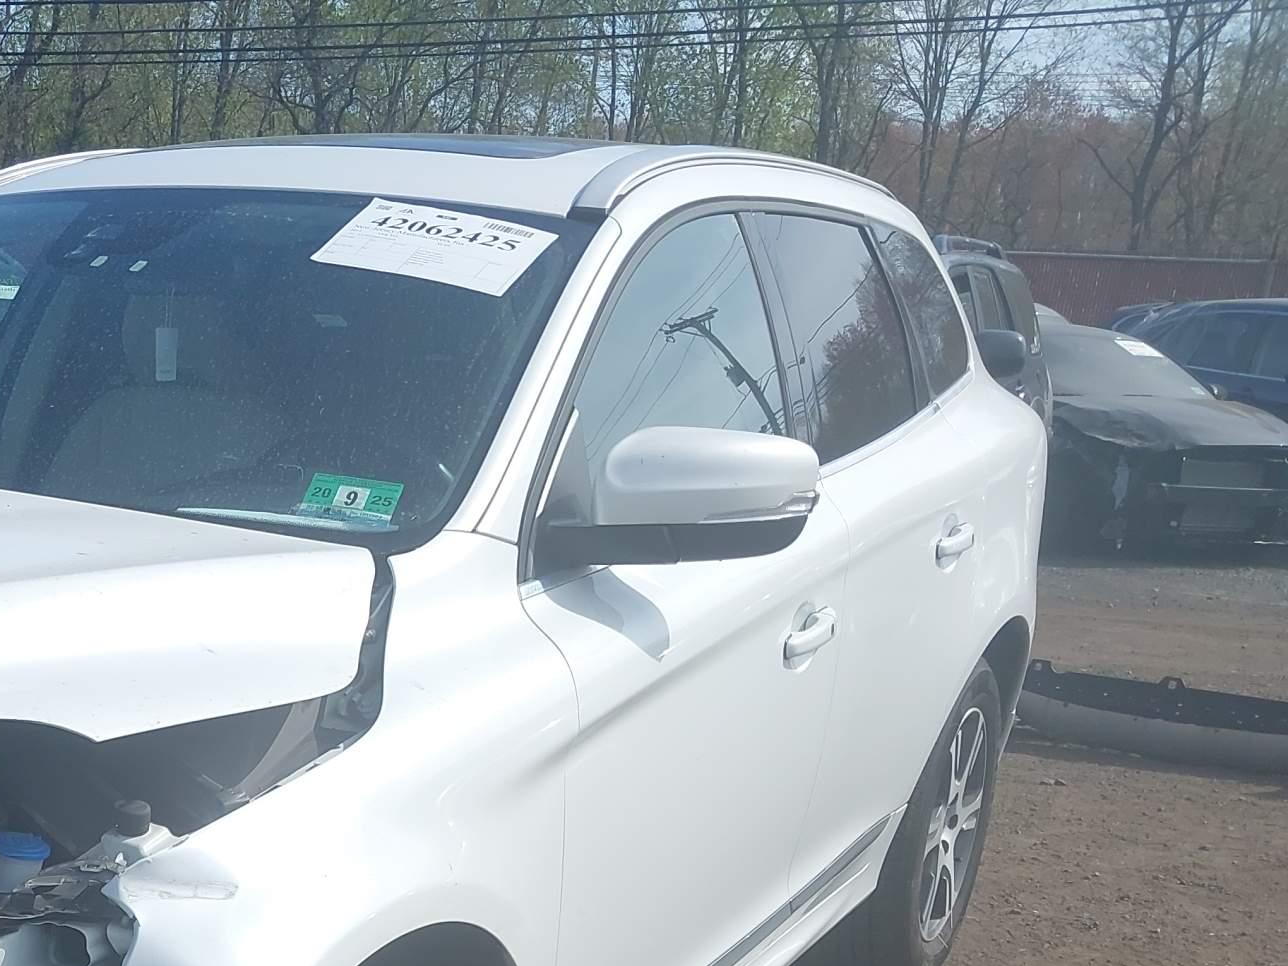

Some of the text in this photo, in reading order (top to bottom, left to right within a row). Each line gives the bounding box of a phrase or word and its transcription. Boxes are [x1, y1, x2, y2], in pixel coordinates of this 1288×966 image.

[371, 216, 521, 252] 42062425
[311, 487, 393, 507] 20 9 25
